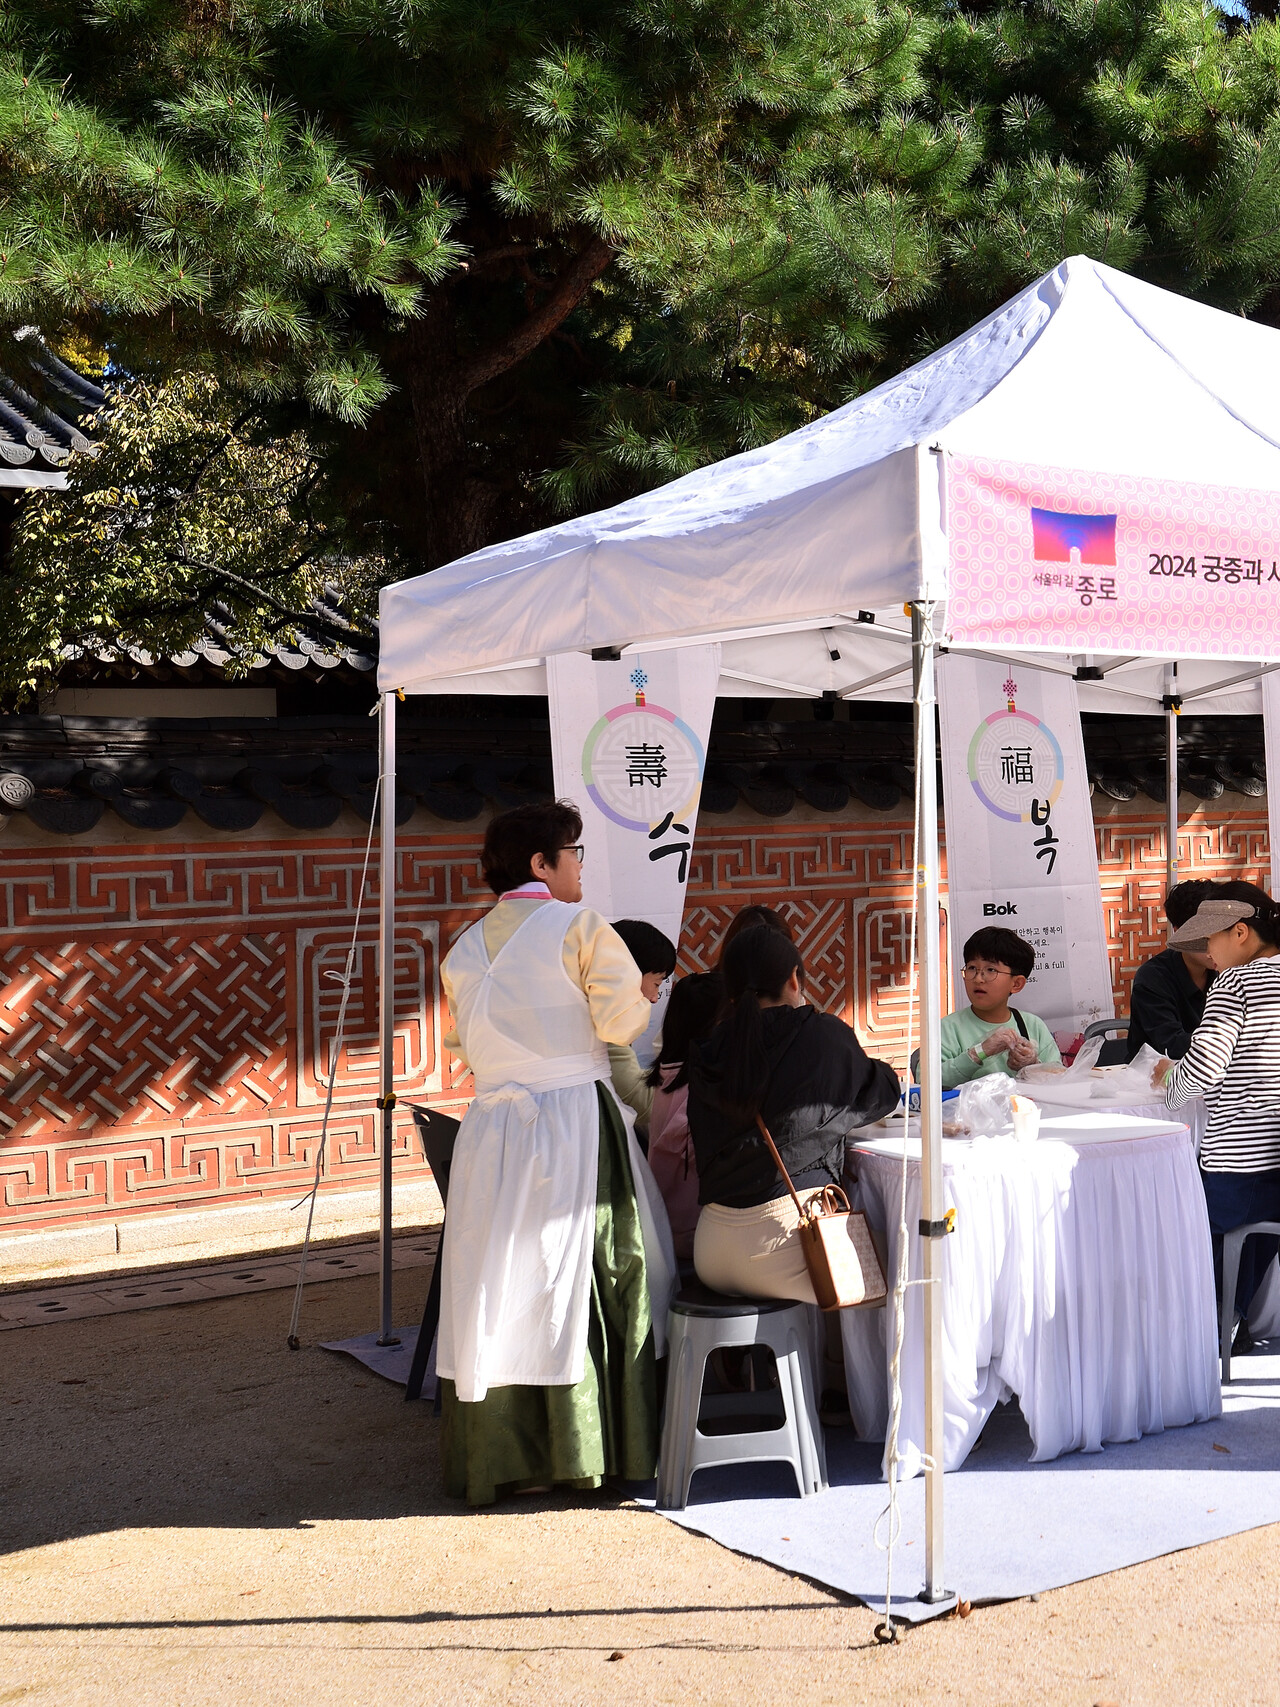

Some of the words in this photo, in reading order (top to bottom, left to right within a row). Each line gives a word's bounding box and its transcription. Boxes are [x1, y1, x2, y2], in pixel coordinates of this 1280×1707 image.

[1149, 553, 1197, 577] 2024
[1202, 555, 1263, 585] 궁중과
[1075, 575, 1118, 606] 종로
[625, 743, 668, 788] 壽
[1000, 746, 1034, 785] 福
[648, 811, 691, 883] 수
[1031, 798, 1059, 875] 복
[983, 901, 1018, 916] Bok
[1052, 961, 1065, 969] full
